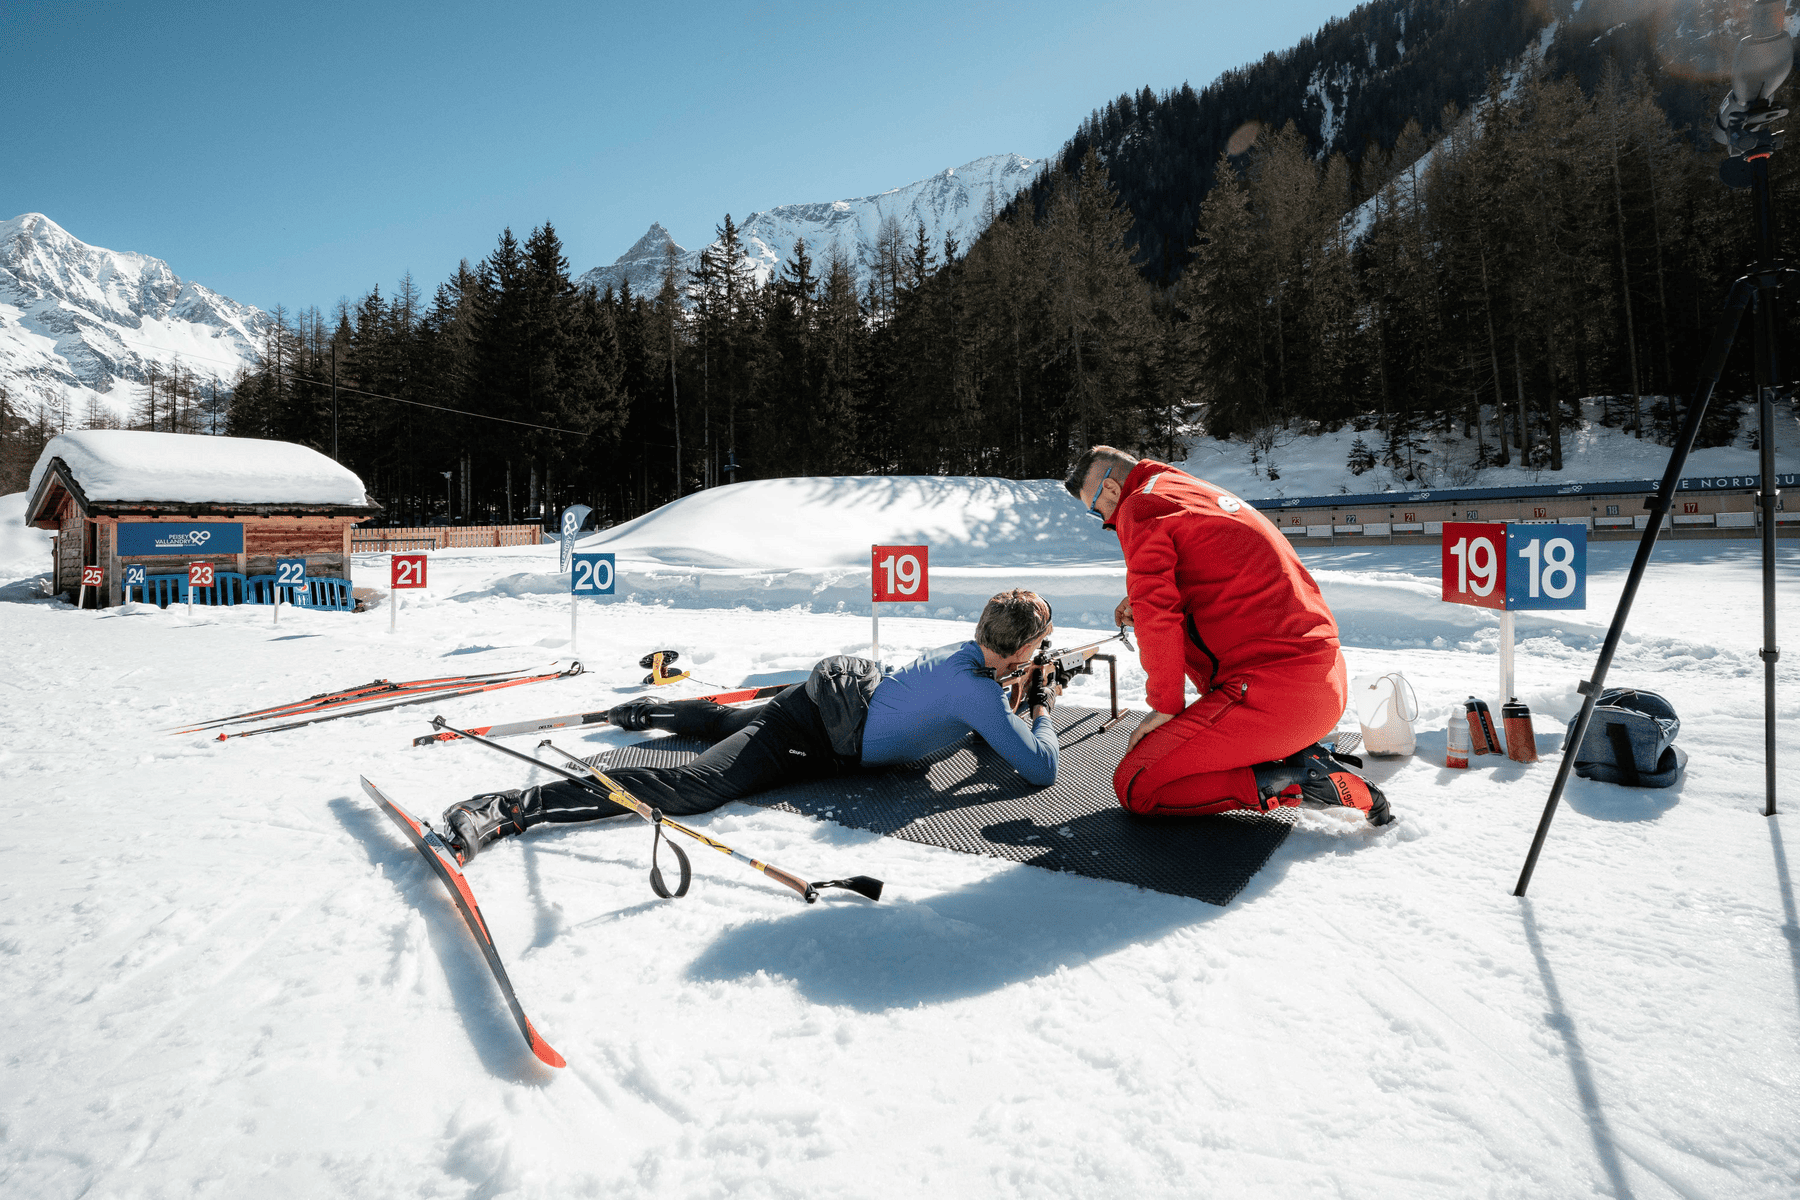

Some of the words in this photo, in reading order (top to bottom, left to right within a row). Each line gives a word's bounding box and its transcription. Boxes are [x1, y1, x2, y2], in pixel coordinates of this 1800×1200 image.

[1652, 480, 1689, 490] SE
[1701, 475, 1795, 488] NORDU
[1468, 511, 1478, 520] 20
[1535, 508, 1546, 517] 19
[1607, 505, 1618, 515] 18
[1686, 503, 1696, 513] 17
[1292, 517, 1301, 525] 23
[1346, 515, 1356, 523] 22
[1406, 514, 1415, 522] 21
[278, 563, 304, 584] 22
[397, 560, 422, 584] 21
[575, 559, 614, 590] 20
[880, 554, 921, 595] 19
[1450, 536, 1498, 597] 19
[1519, 537, 1576, 599] 18
[84, 569, 102, 585] 25
[128, 568, 145, 584] 24
[191, 566, 213, 584] 23
[1337, 774, 1356, 808] SIGNOL
